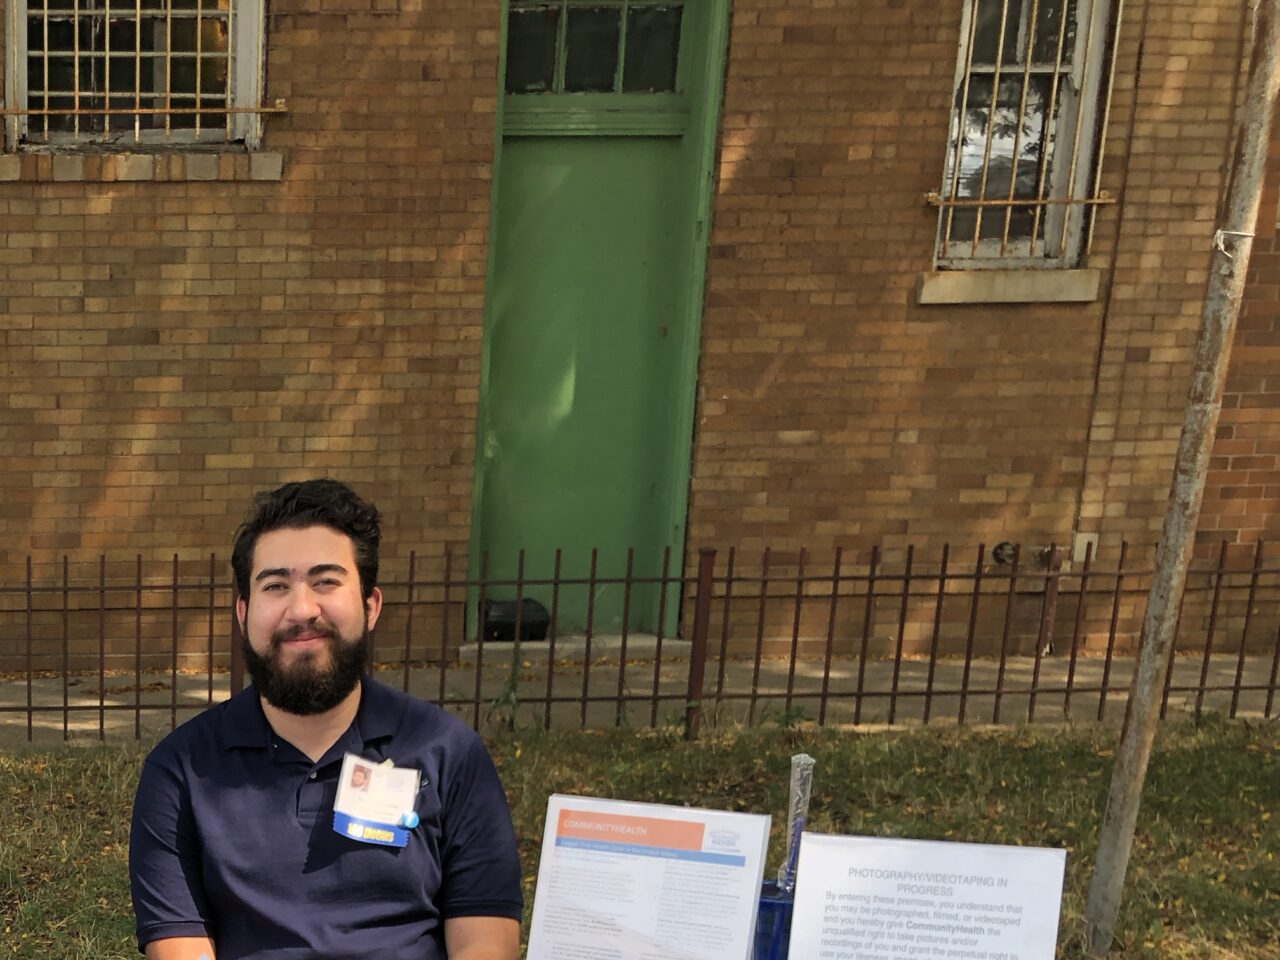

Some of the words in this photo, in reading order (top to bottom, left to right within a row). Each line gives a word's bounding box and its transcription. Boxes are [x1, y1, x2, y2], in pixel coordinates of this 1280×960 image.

[563, 820, 647, 836] COMMUNITYHEALTH
[847, 868, 994, 887] PHOTOGRAPHY/VIDEOTAPING
[996, 879, 1007, 888] IN
[896, 883, 953, 896] PROGRESS
[826, 891, 836, 901] By
[838, 892, 870, 903] entering
[873, 894, 895, 903] these
[897, 896, 936, 909] premises,
[938, 901, 954, 910] you
[956, 901, 1003, 912] understand
[1006, 905, 1022, 913] that
[823, 914, 838, 922] and
[840, 917, 854, 926] you
[886, 919, 903, 930] give
[905, 921, 984, 937] CommunityHealth
[987, 928, 1000, 936] the
[824, 904, 838, 913] you
[840, 905, 857, 914] may
[860, 905, 870, 913] be
[871, 906, 930, 920] photographed,
[973, 914, 1020, 928] videotaped
[822, 926, 864, 938] unqualified
[867, 929, 885, 940] right
[887, 931, 894, 939] to
[896, 932, 914, 940] take
[916, 934, 949, 945] pictures
[821, 937, 862, 950] recordings
[864, 941, 872, 949] of
[874, 943, 889, 952] you
[891, 943, 906, 952] and
[908, 945, 930, 956] grant
[932, 947, 945, 955] the
[947, 948, 986, 960] perpetual
[836, 952, 853, 960] your
